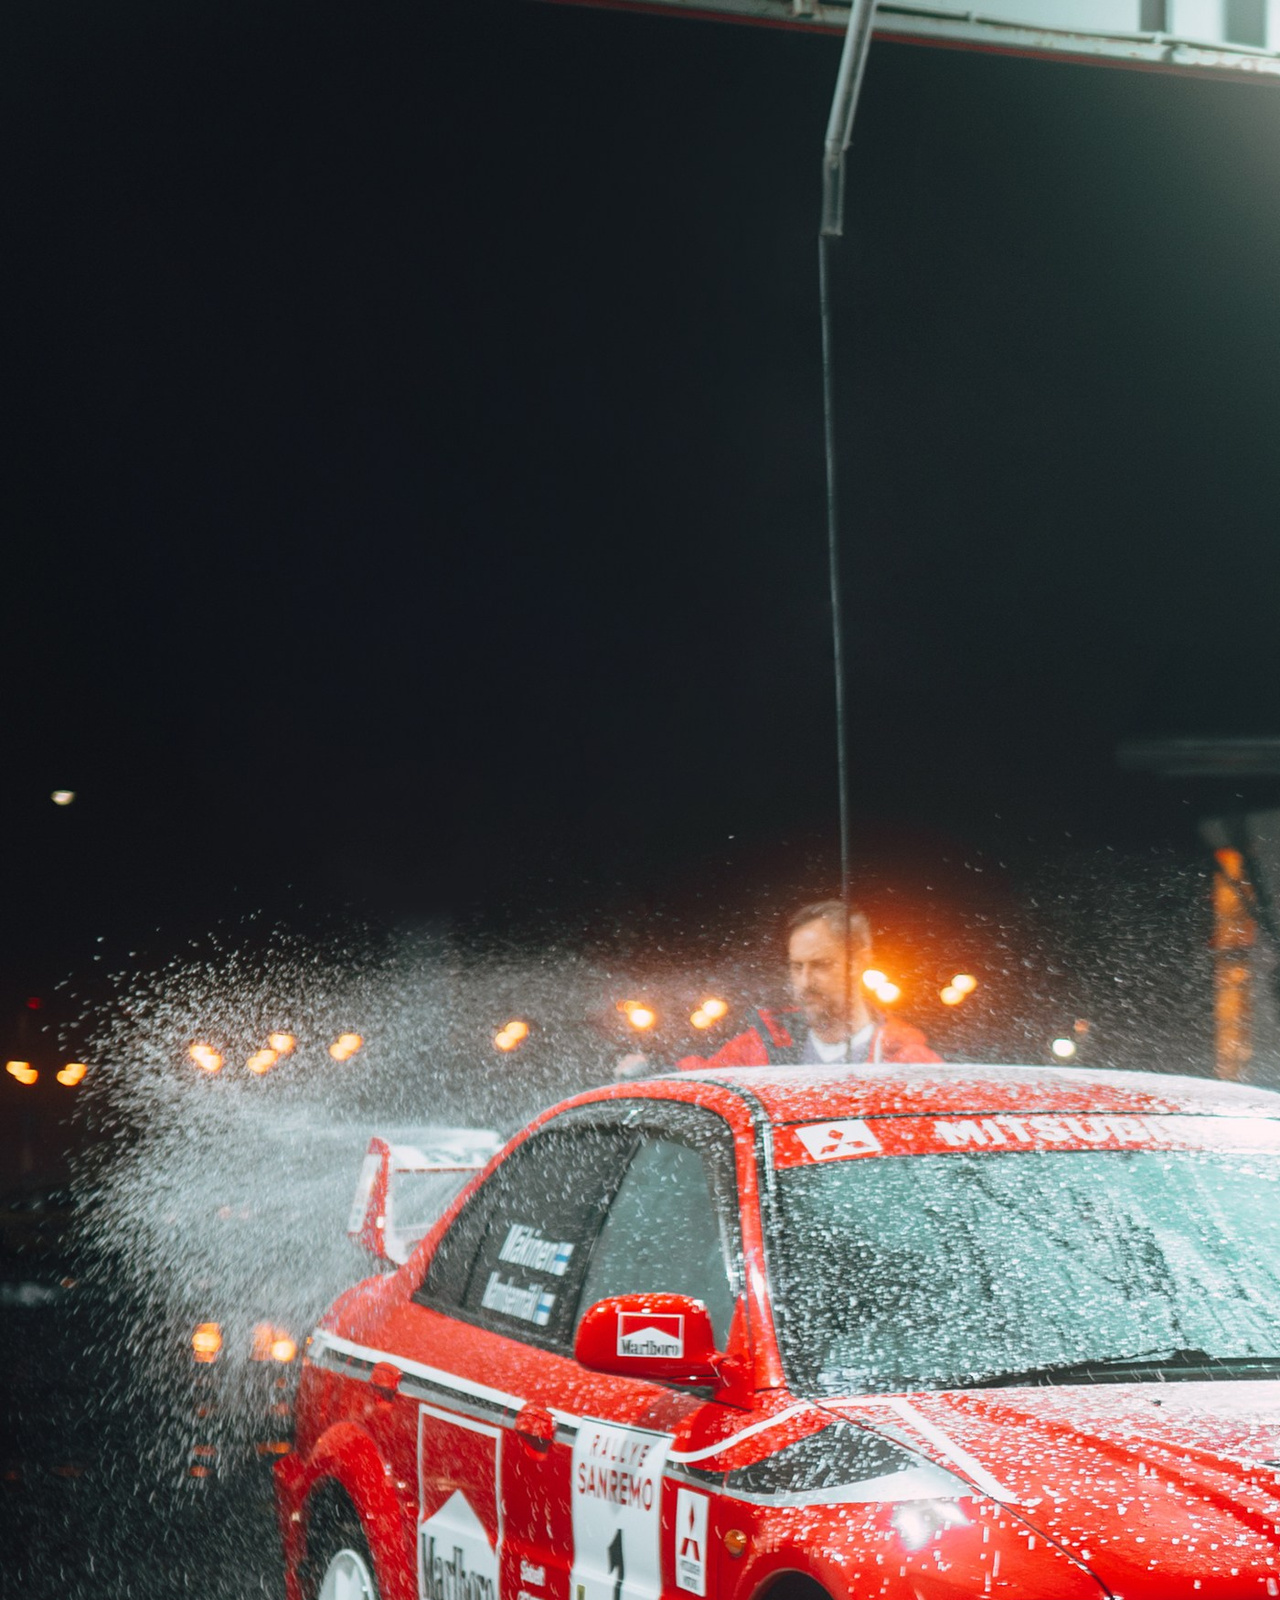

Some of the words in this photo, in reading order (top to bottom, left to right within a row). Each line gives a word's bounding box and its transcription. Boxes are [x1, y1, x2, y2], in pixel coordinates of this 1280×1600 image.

[621, 1339, 678, 1356] Marlboro
[590, 1434, 651, 1468] RALLYE
[577, 1462, 654, 1512] SANREMO
